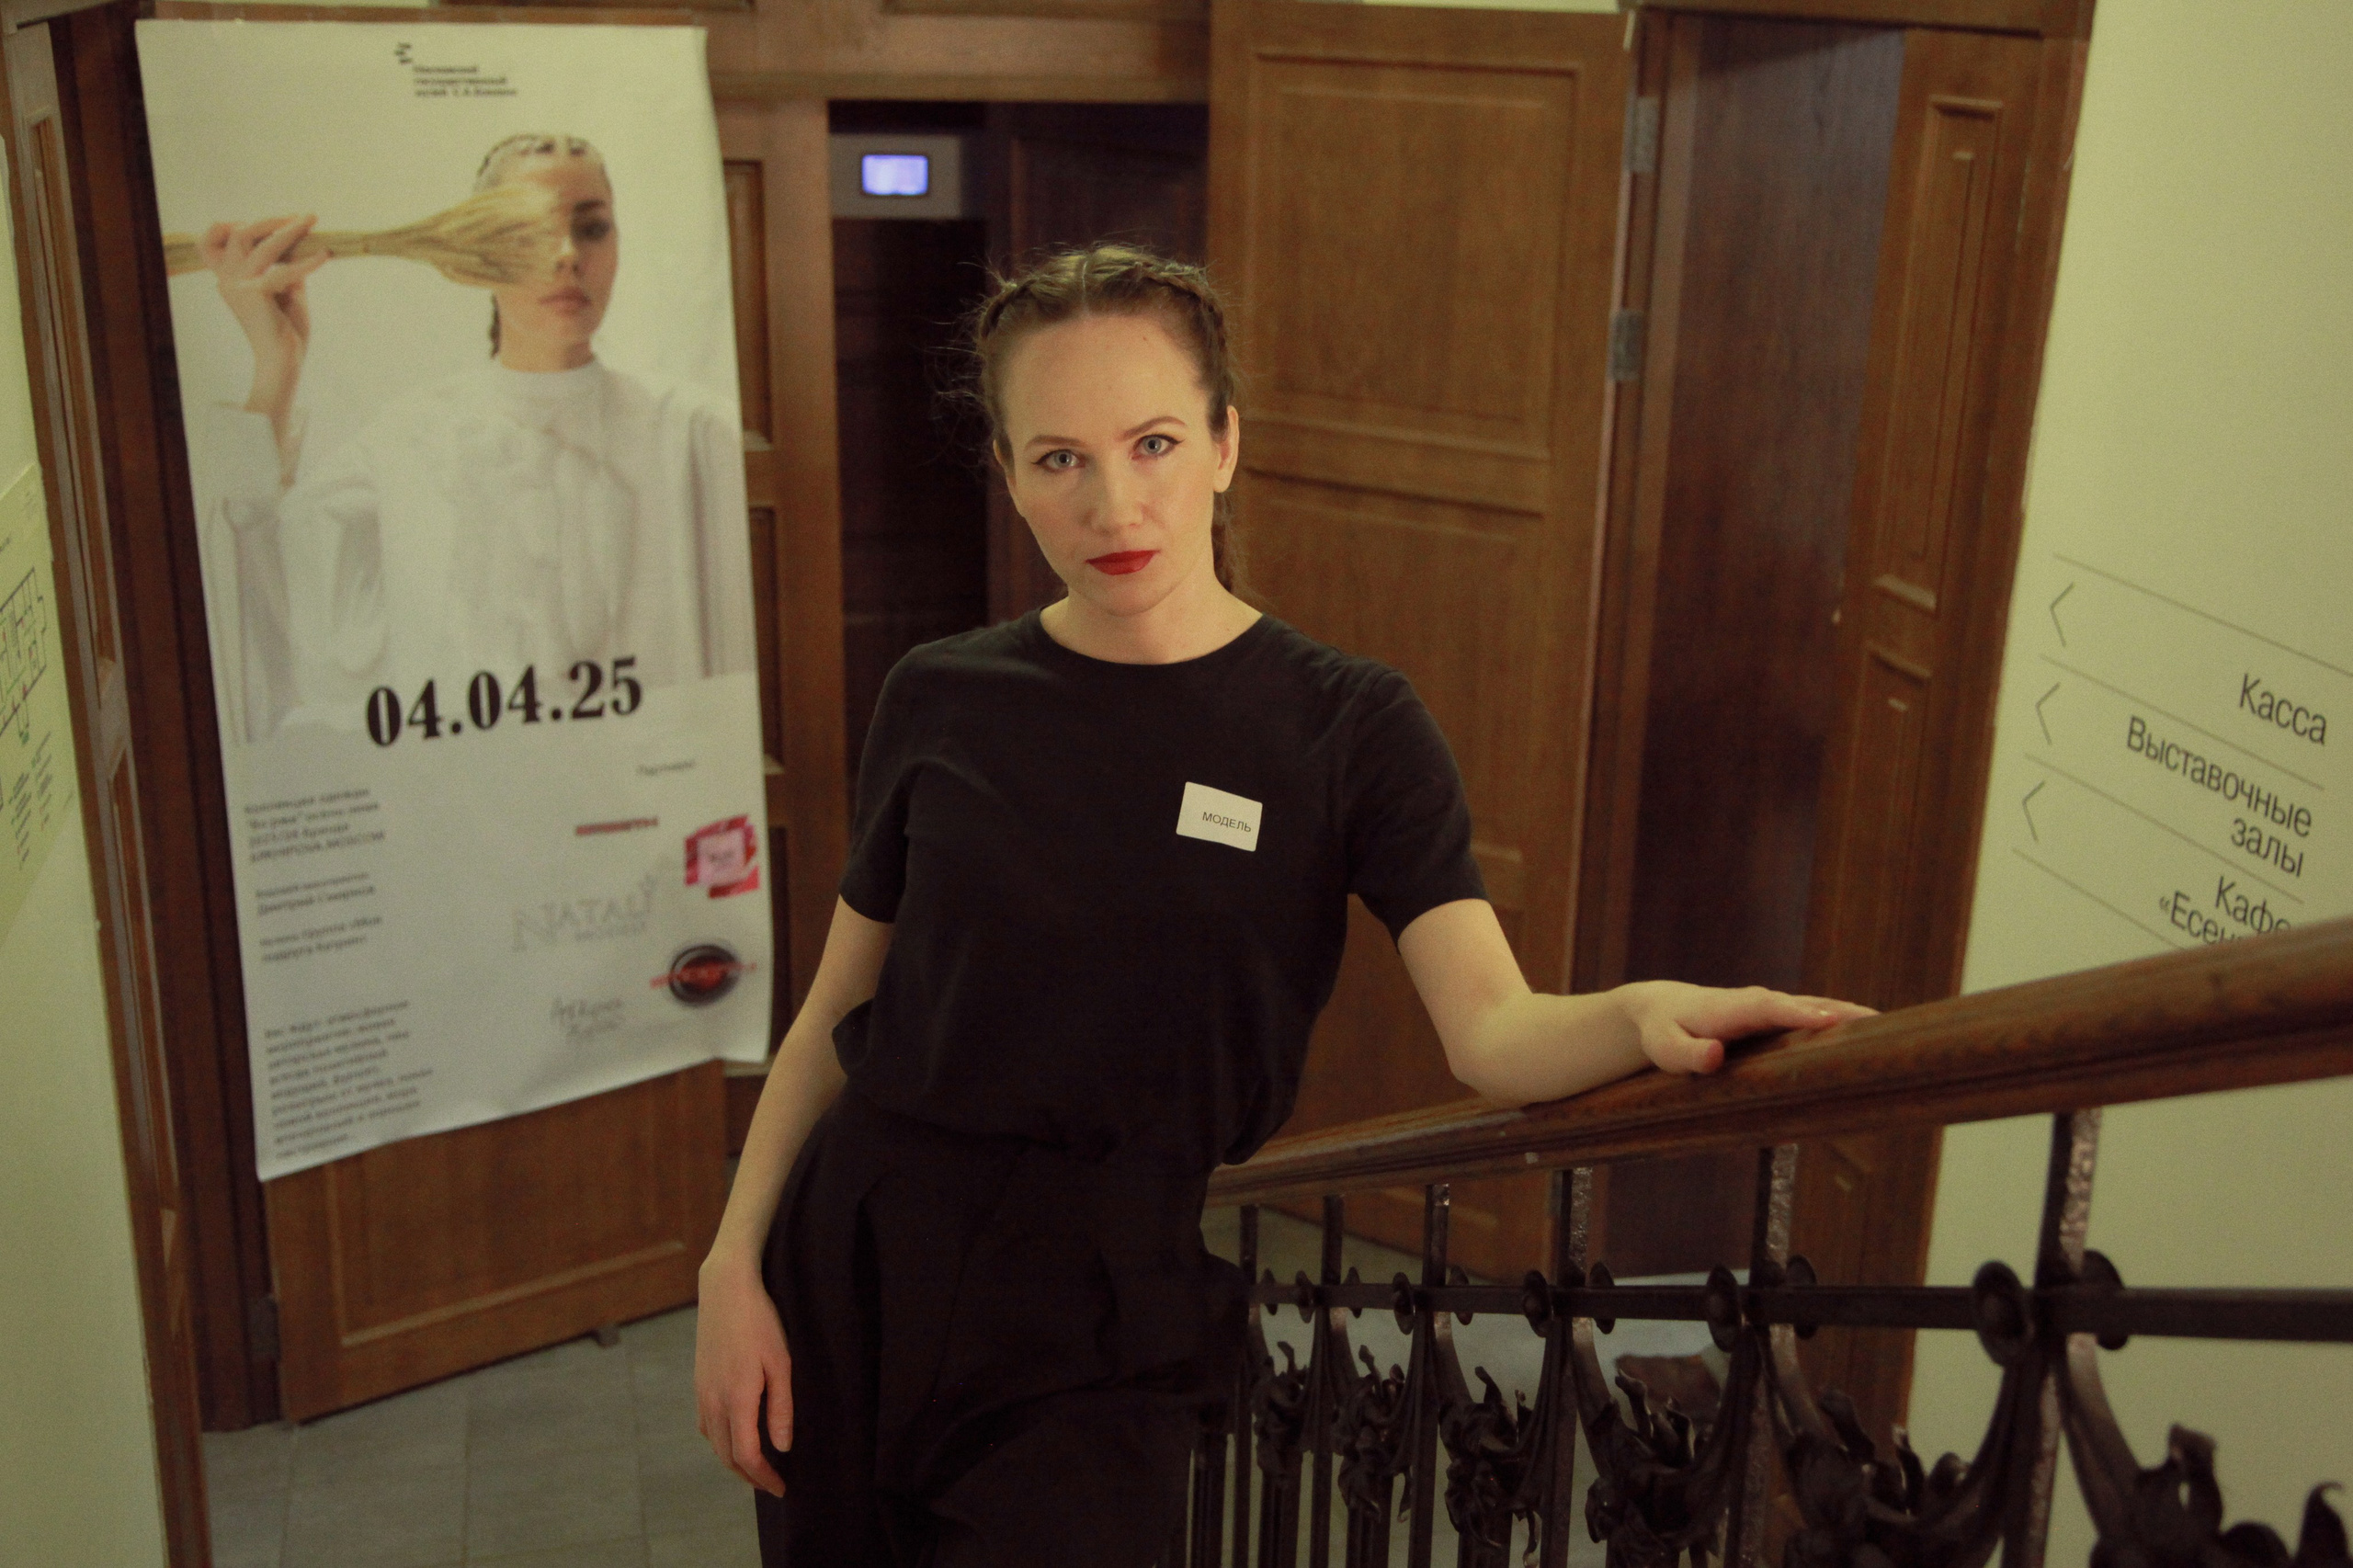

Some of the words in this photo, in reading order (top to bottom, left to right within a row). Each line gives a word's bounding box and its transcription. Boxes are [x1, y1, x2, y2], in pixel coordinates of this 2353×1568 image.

[367, 655, 642, 747] 04.04.25
[2239, 673, 2327, 745] Касса
[2126, 715, 2313, 838] Выставочные
[1201, 811, 1253, 834] МОДЕЛЬ
[2231, 817, 2304, 878] залы
